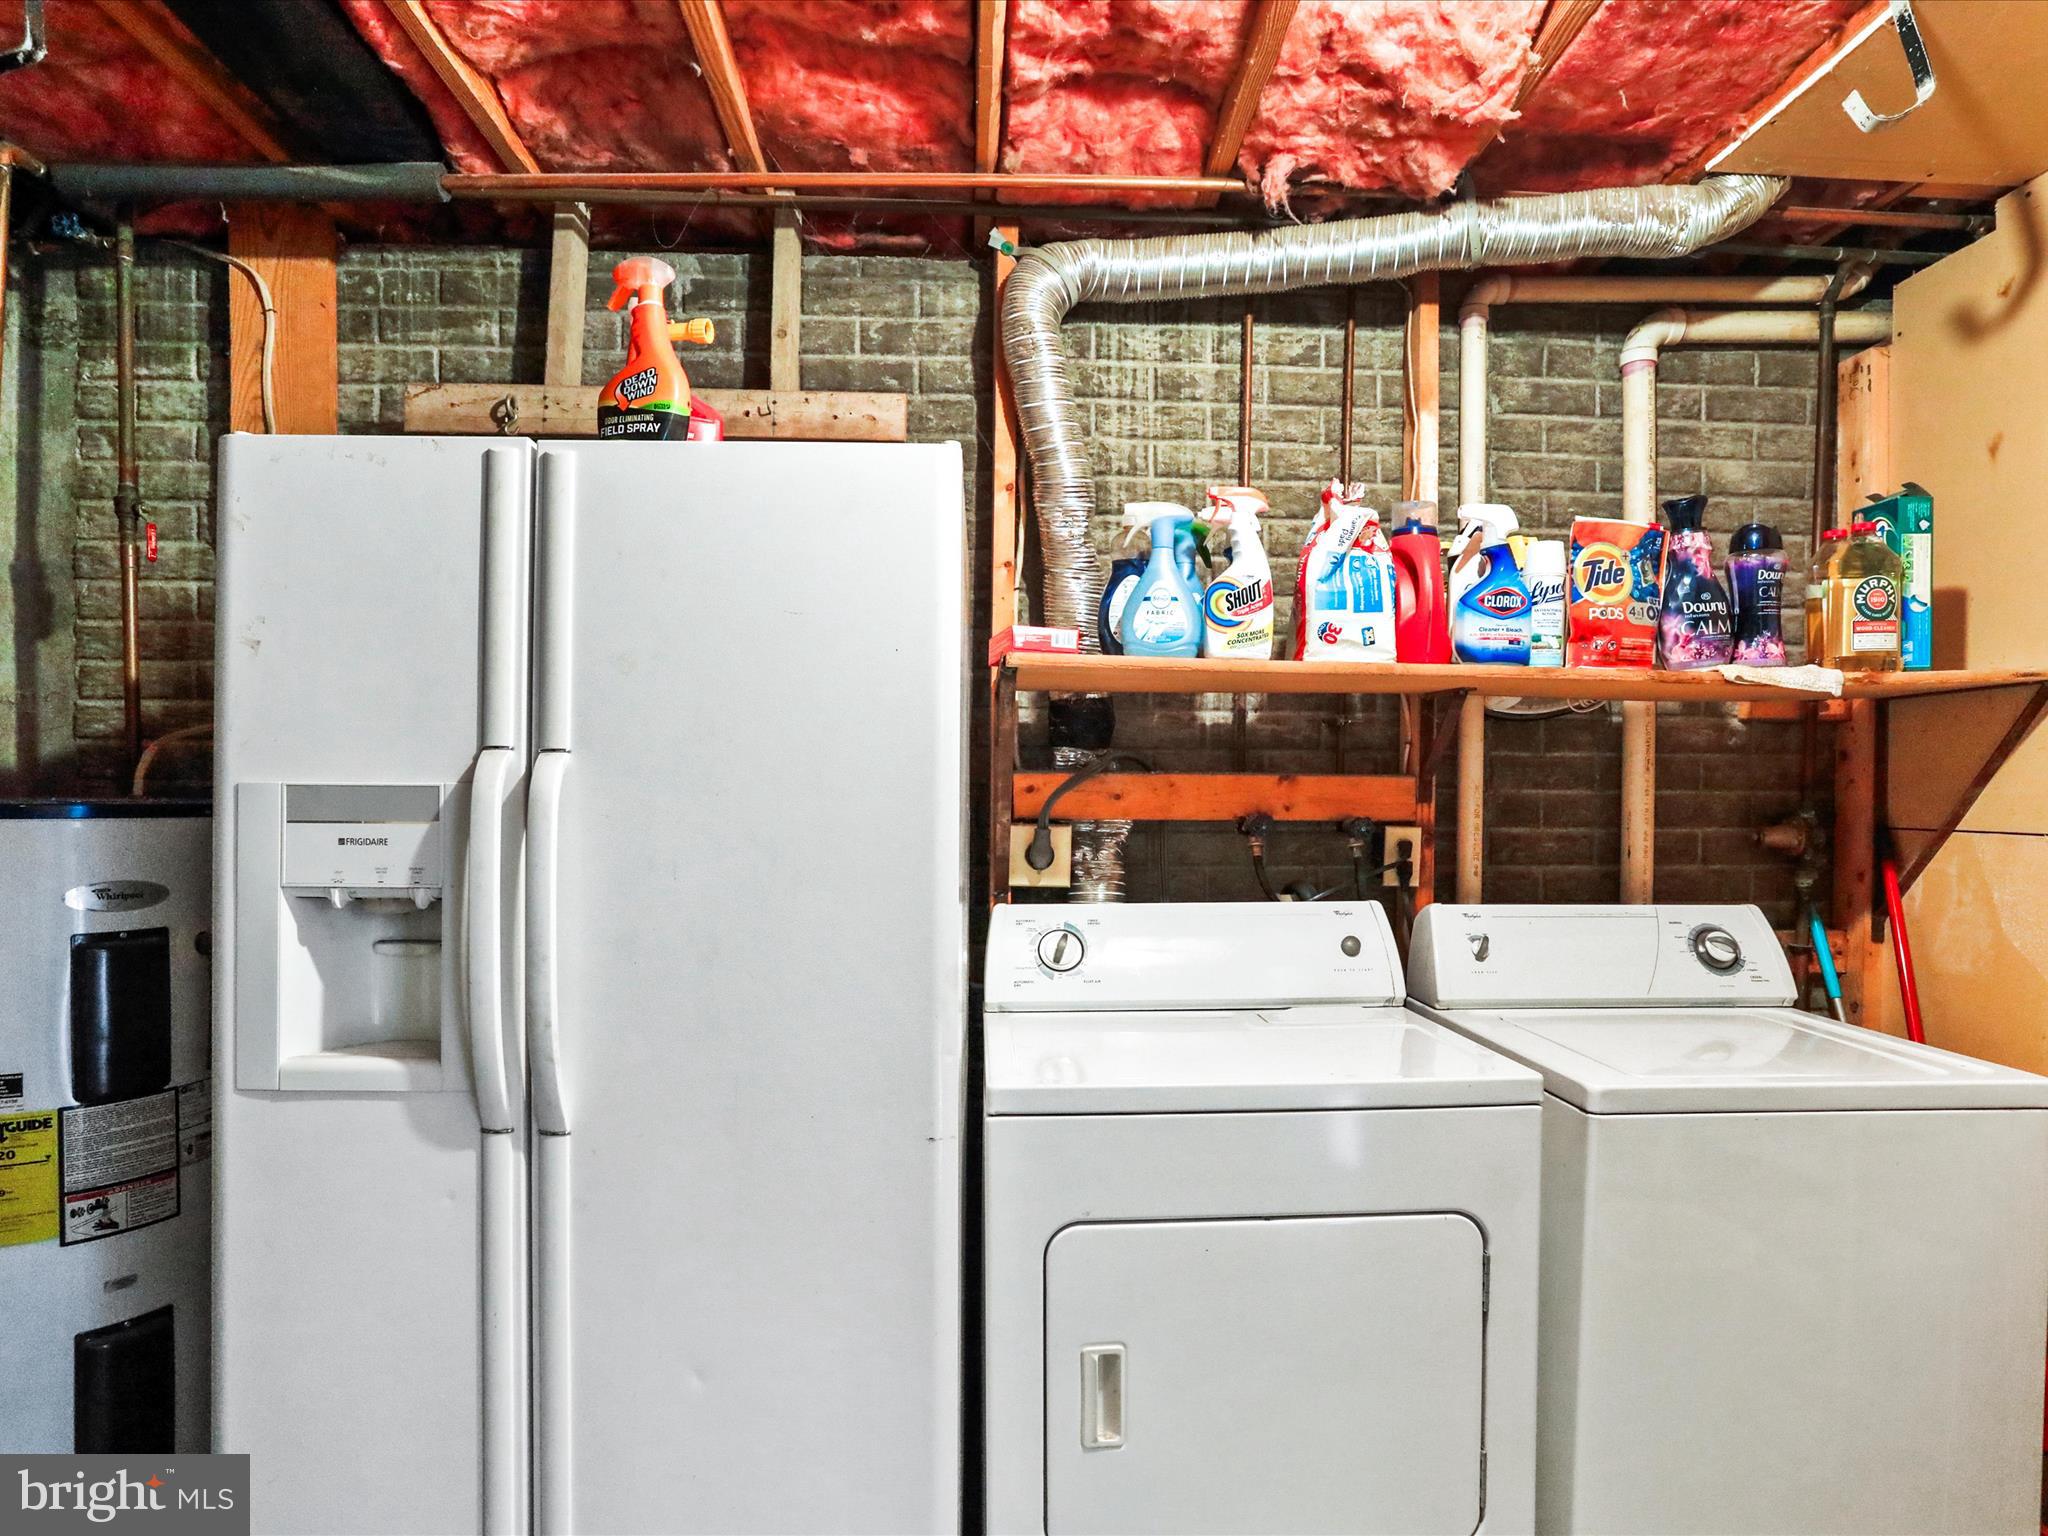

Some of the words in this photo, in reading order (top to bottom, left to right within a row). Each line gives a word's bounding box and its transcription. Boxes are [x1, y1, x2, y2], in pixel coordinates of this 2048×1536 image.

[624, 367, 656, 387] DEAD
[623, 375, 657, 394] DOWN
[627, 385, 655, 401] WIND
[605, 416, 618, 425] ODOR
[619, 413, 654, 424] ELIMINATING
[600, 424, 625, 438] FIELD
[626, 423, 661, 434] SPRAY
[1582, 559, 1626, 593] Tide
[1757, 569, 1784, 581] Down
[1225, 579, 1262, 612] SHOUT
[1758, 586, 1777, 598] CAL
[1856, 578, 1896, 605] MURPHY
[1484, 595, 1522, 608] CLOROX
[1682, 601, 1727, 615] Downy
[1589, 607, 1624, 620] PODS
[1249, 628, 1265, 638] MORE
[1322, 623, 1343, 645] 30
[1681, 620, 1732, 636] CALM
[1227, 632, 1270, 646] CONCENTRATED
[346, 837, 388, 846] FRIGIDAIRE
